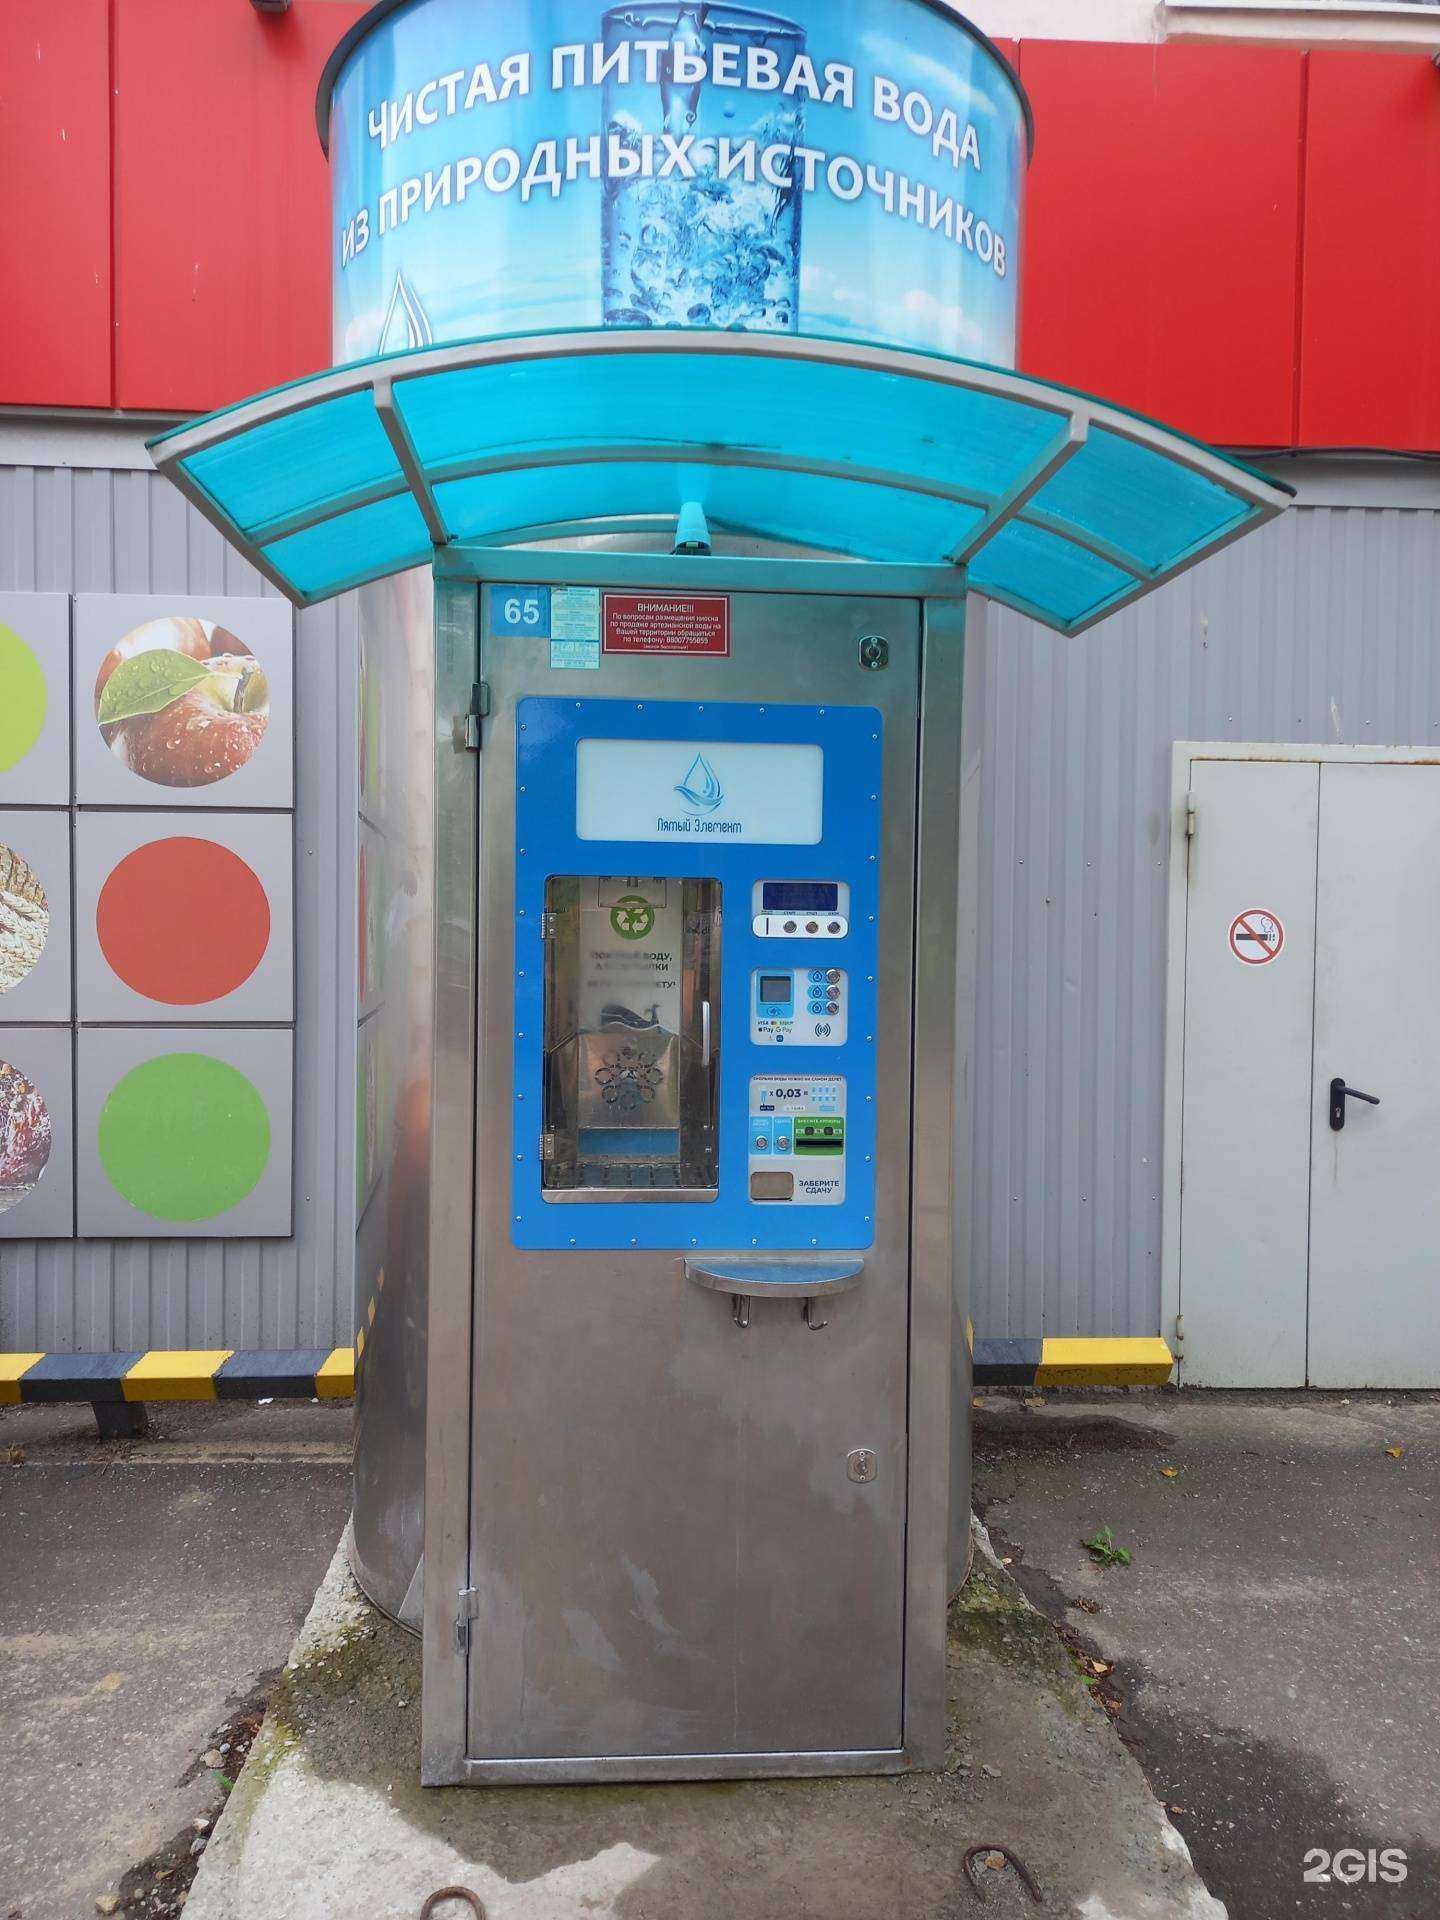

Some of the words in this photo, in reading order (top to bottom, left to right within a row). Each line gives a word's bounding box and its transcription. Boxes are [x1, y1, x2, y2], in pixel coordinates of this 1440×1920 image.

[367, 53, 532, 149] ЧИСТАЯ
[552, 40, 854, 109] ПИТЬЕВАЯ
[873, 77, 981, 171] ВОДА
[340, 210, 370, 268] ИЗ
[378, 134, 697, 228] ПРИРОДНЫХ
[719, 139, 1007, 277] ИСТОЧНИКОВ
[504, 598, 540, 625] 65
[637, 603, 695, 613] ВНИМАНИЕ!!!
[612, 612, 622, 620] По
[657, 817, 691, 832] Пятый
[694, 818, 742, 833] Элемент
[763, 1026, 774, 1034] Pay
[776, 1088, 802, 1099] 0,03
